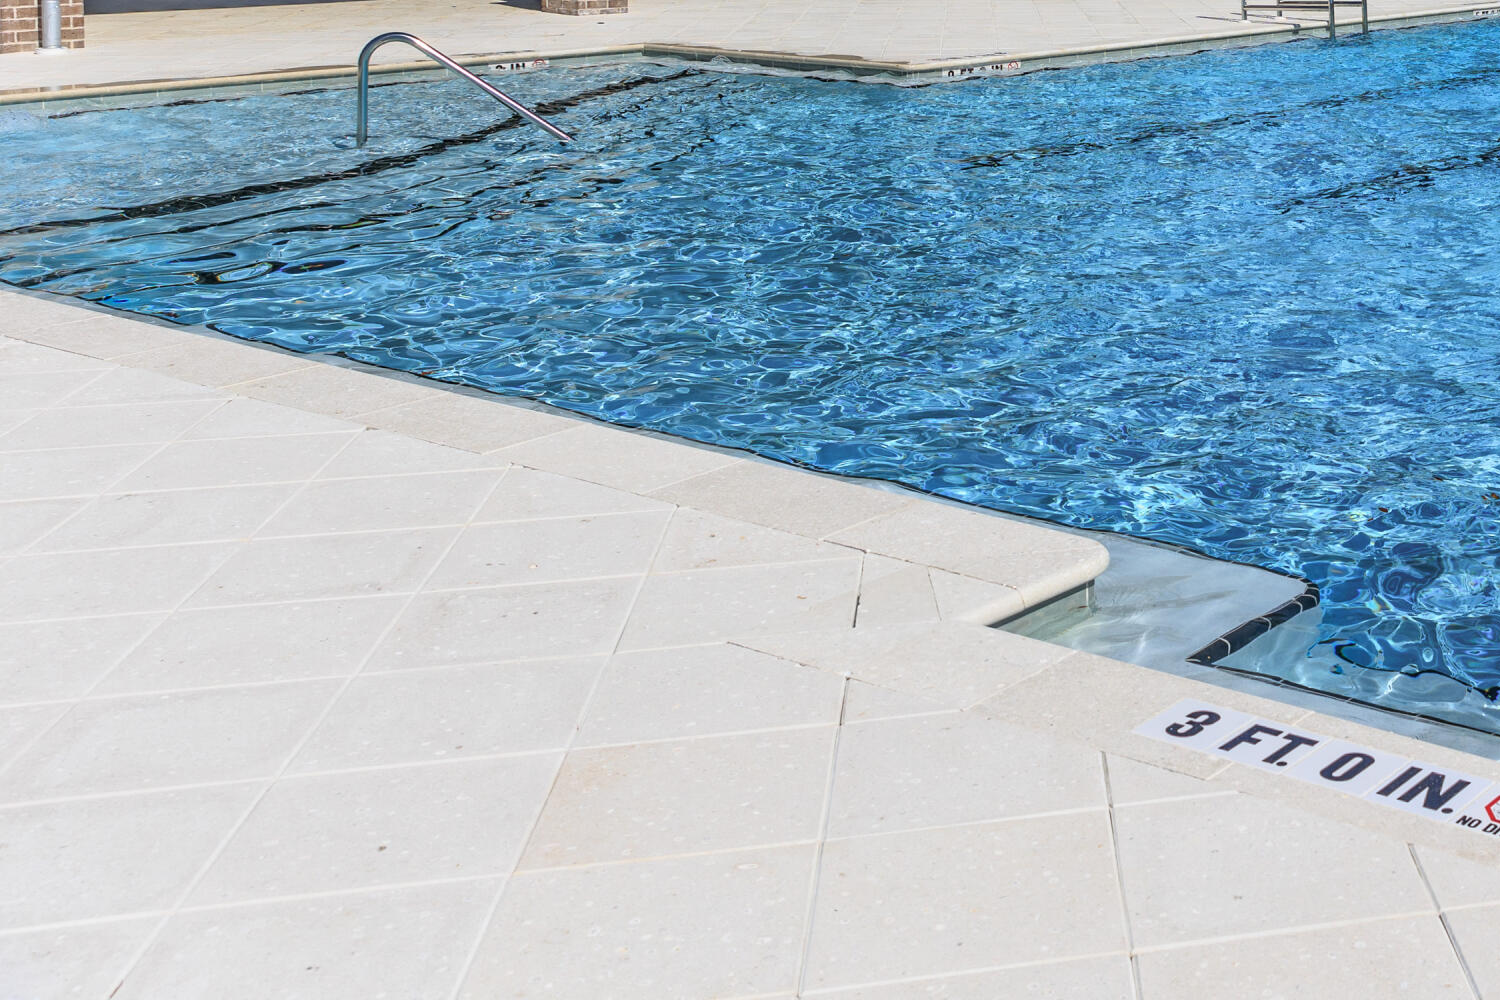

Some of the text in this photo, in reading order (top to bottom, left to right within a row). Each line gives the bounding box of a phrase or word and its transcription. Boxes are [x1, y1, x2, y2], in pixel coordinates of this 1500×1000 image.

[1165, 709, 1221, 738] 3
[1219, 723, 1319, 768] FT.
[1376, 766, 1472, 815] IN.
[1455, 814, 1484, 830] NO
